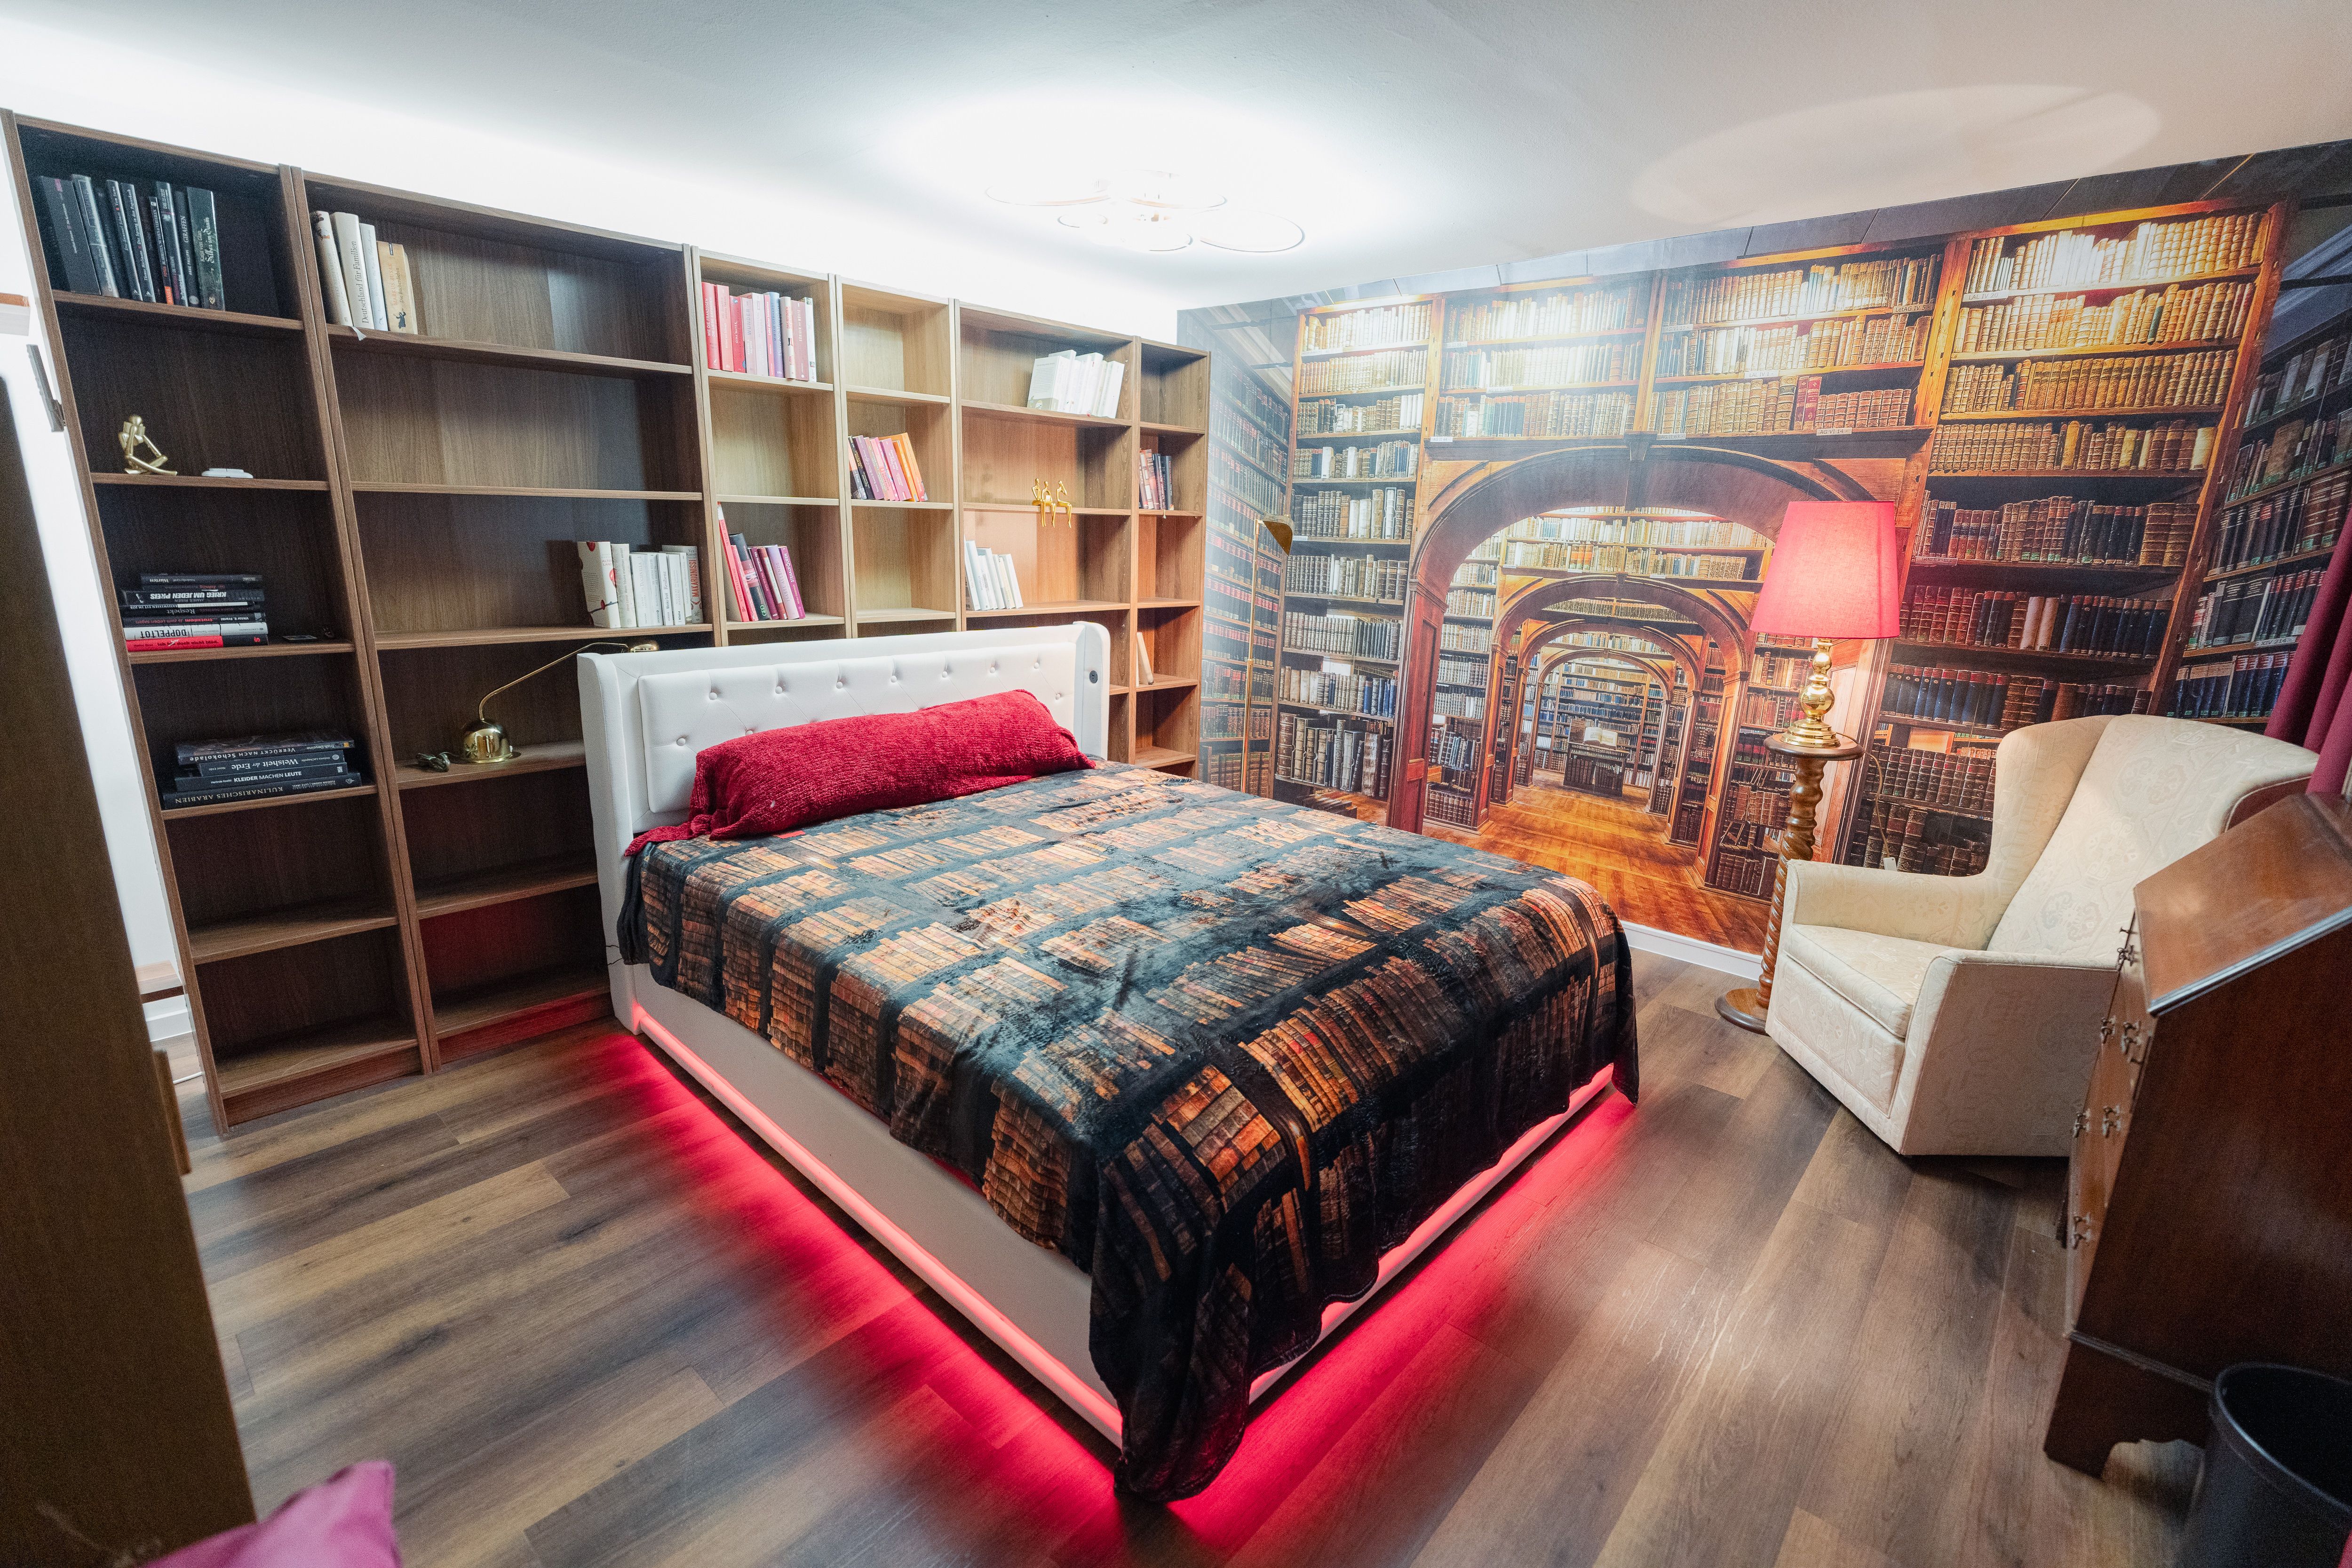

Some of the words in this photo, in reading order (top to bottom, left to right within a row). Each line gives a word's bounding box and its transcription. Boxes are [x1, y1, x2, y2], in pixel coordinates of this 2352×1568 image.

[180, 215, 189, 243] GIRAFFEN
[199, 216, 211, 235] Saum
[204, 244, 215, 263] Silber
[349, 240, 360, 270] Familien
[354, 270, 362, 282] für
[356, 283, 369, 324] Deutschland
[775, 562, 785, 584] ALLENDE
[783, 553, 795, 582] STEHAUFQUEEN
[689, 559, 699, 597] MAKARIONISSI
[732, 568, 743, 602] ORCHESTERBILDER
[140, 629, 186, 638] DOPPELTOT
[189, 753, 236, 762] Schokolade
[231, 762, 250, 771] Erde
[262, 758, 298, 767] Weisheit
[174, 794, 214, 804] ARABIEN
[216, 786, 283, 799] KULINARISCHES
